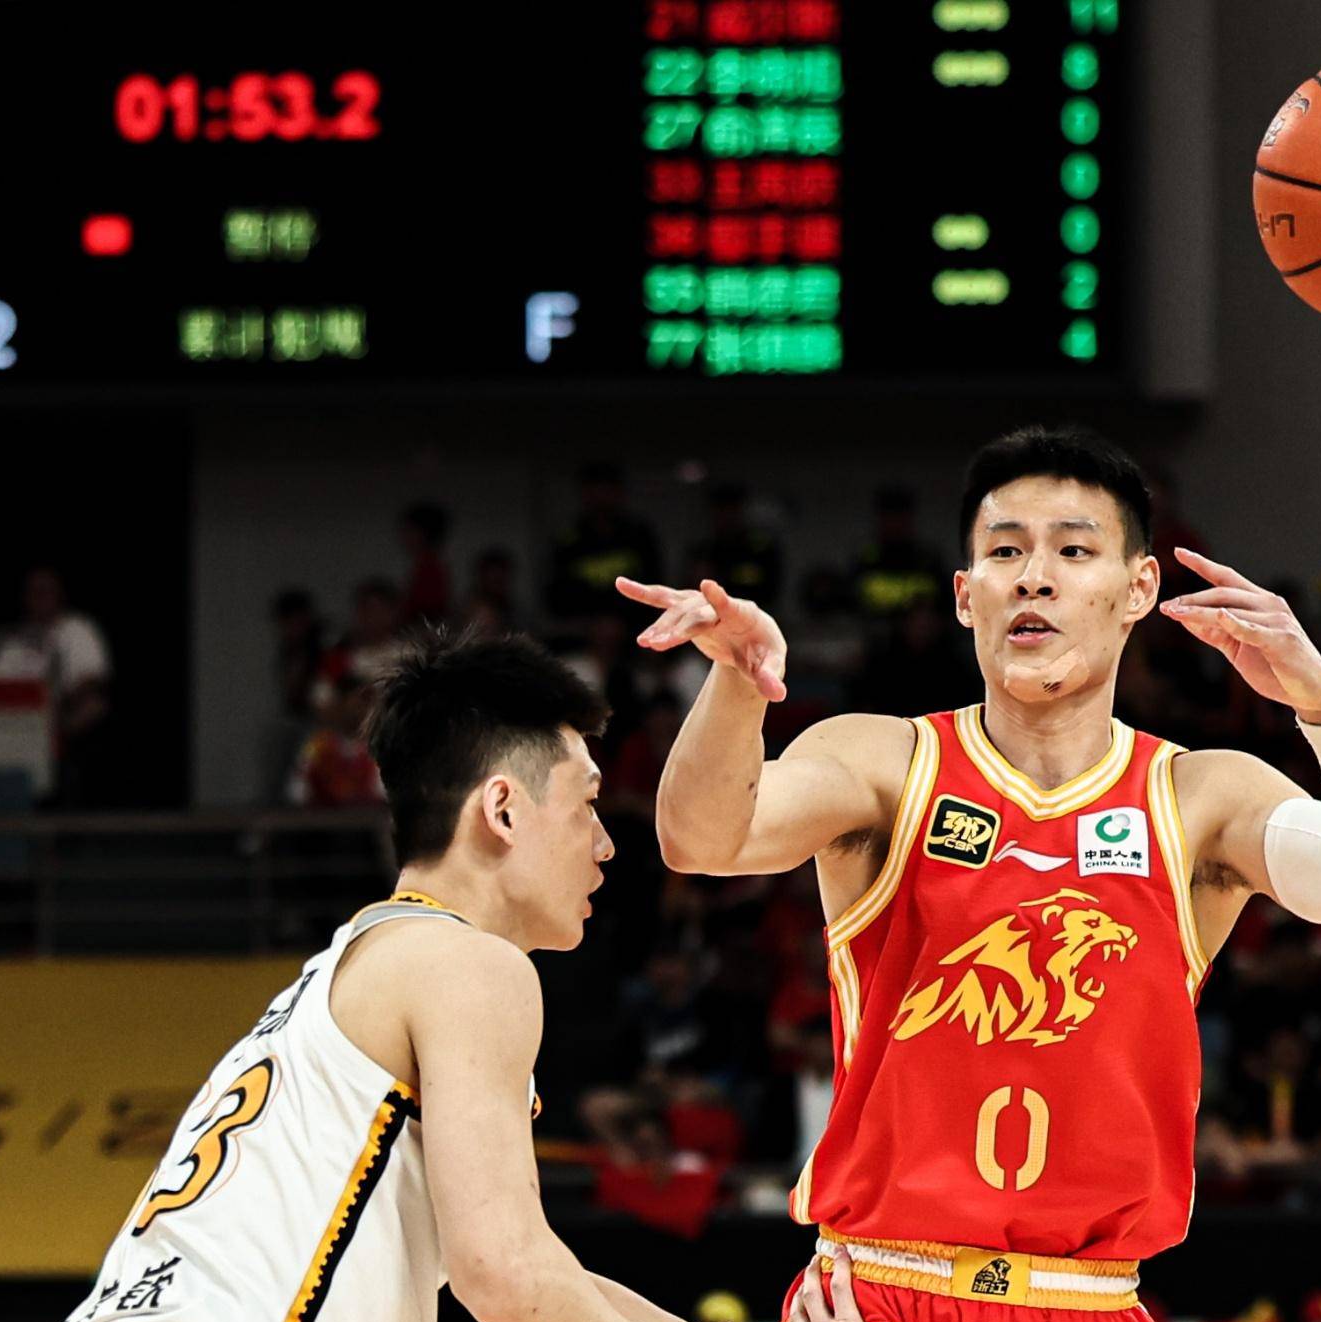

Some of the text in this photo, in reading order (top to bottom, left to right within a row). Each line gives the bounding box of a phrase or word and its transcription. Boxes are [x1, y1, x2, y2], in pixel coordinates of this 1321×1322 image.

[115, 70, 380, 142] 01:53.2
[525, 291, 579, 363] F
[944, 836, 978, 855] CBA
[1084, 849, 1143, 861] 中国人寿
[1085, 861, 1143, 869] CHINA LIFE
[123, 1056, 278, 1237] 3
[975, 1086, 1050, 1191] 0
[972, 1280, 1007, 1295] 浙江
